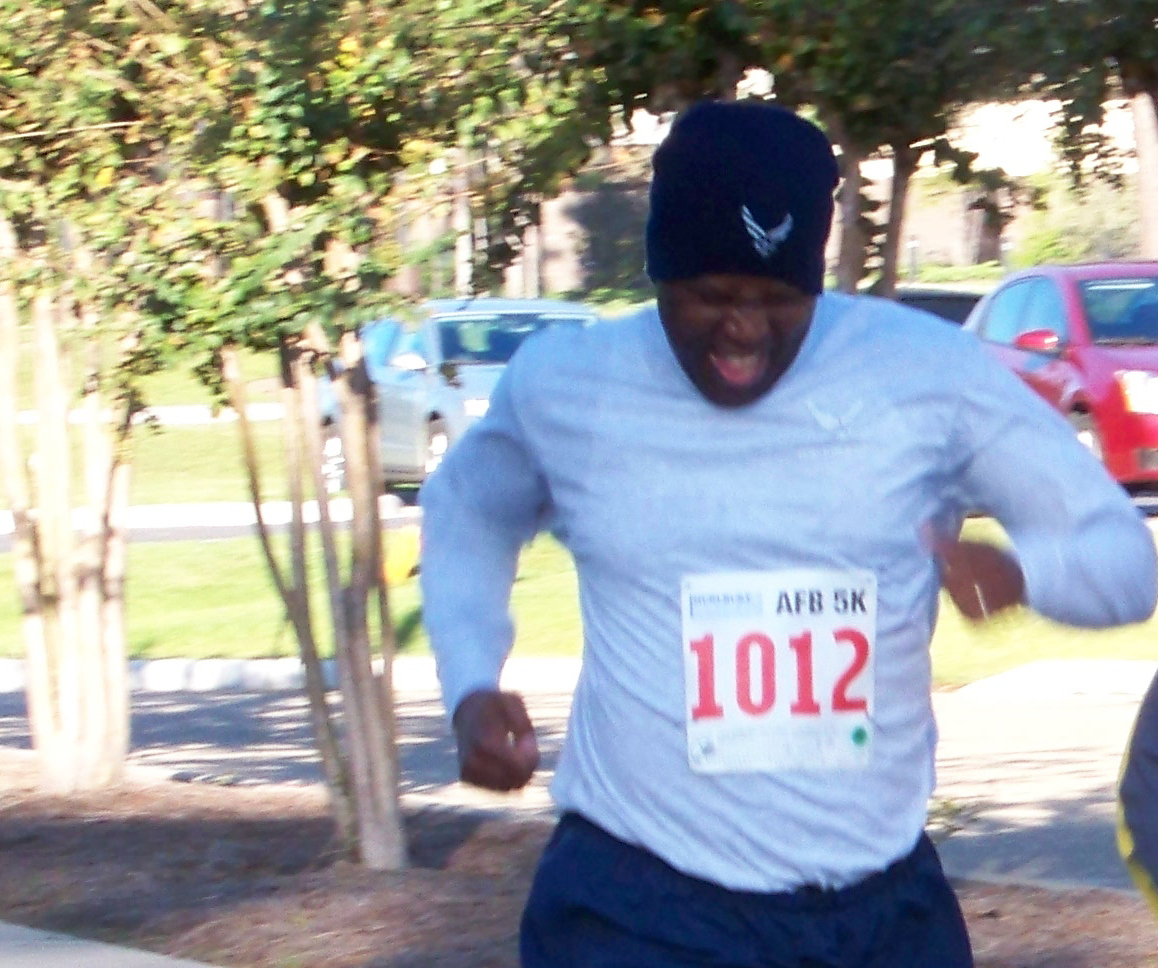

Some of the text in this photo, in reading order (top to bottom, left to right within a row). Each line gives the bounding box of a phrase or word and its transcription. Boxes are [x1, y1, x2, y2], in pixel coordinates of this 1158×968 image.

[776, 588, 824, 615] AFB
[833, 587, 868, 615] 5K
[689, 626, 870, 721] 1012
